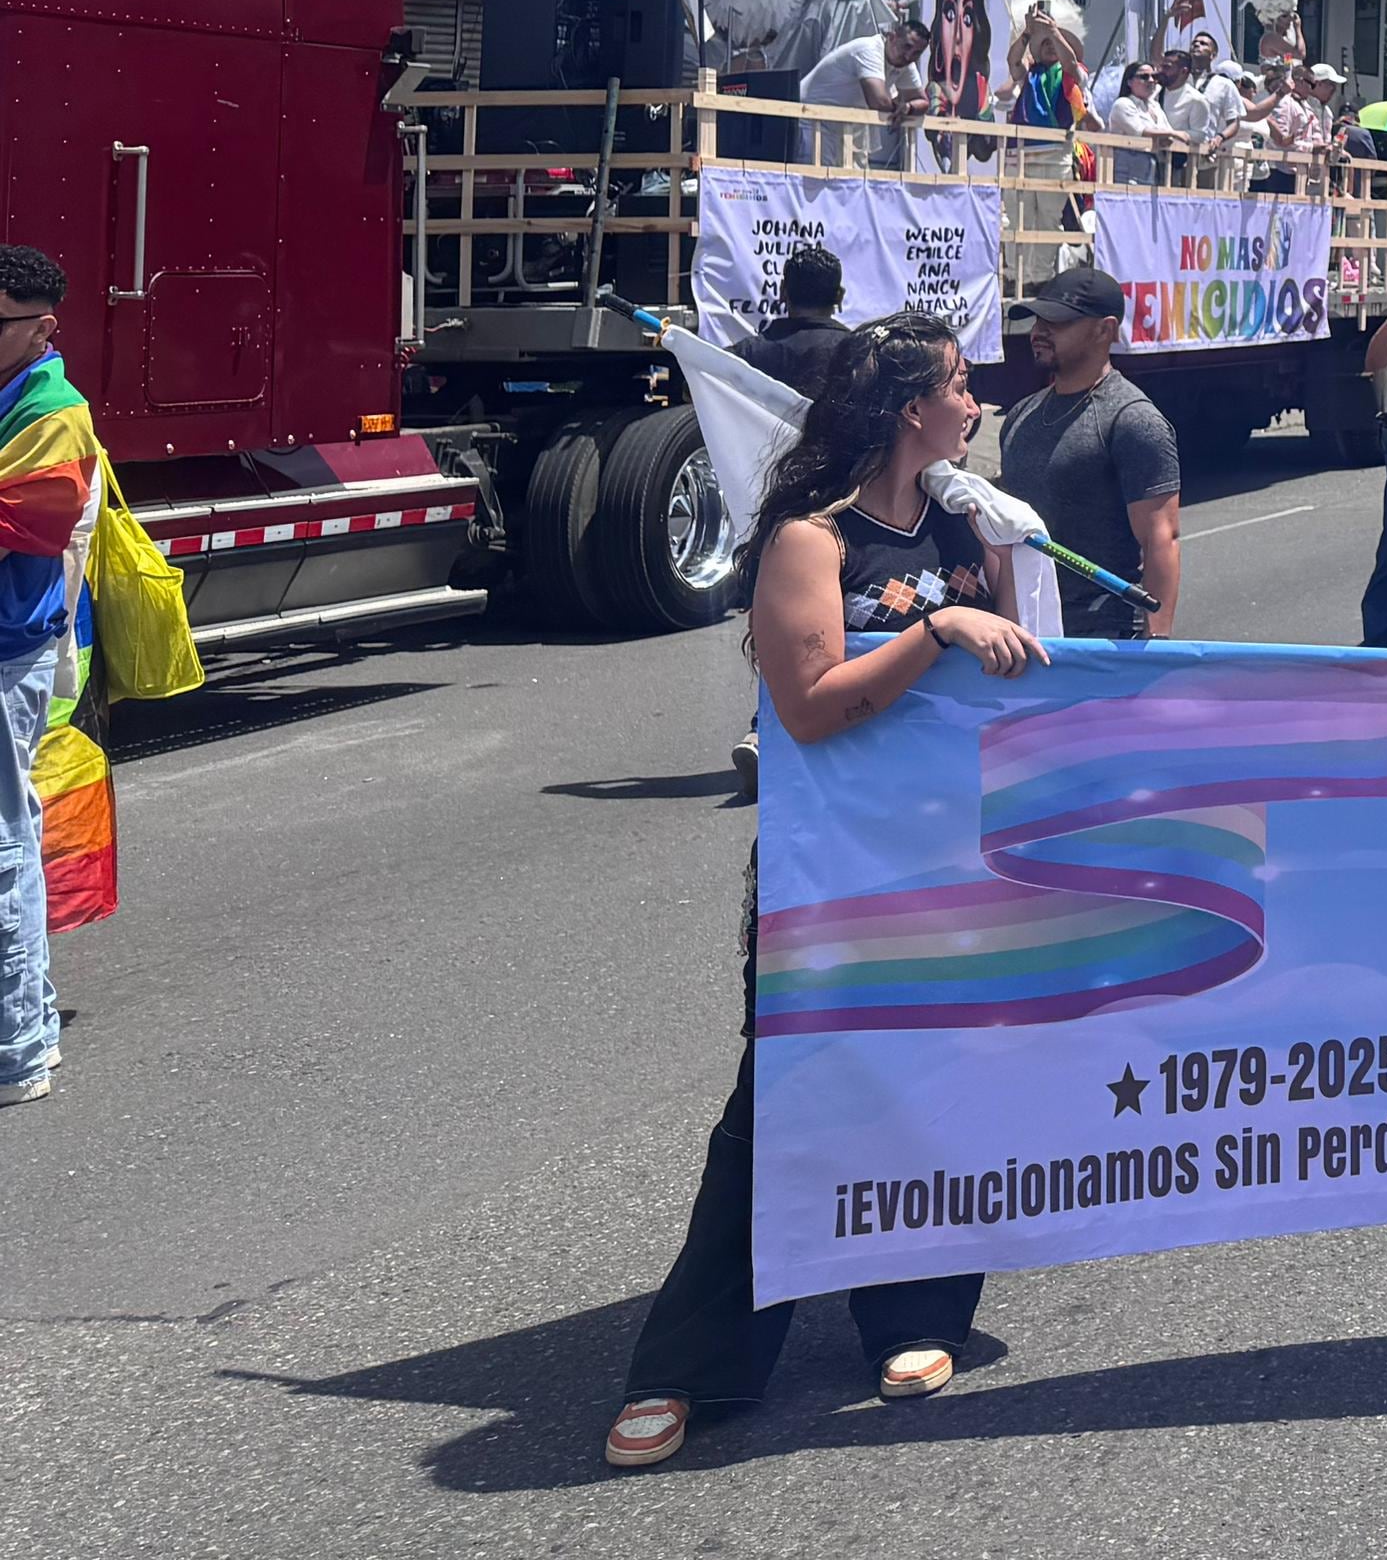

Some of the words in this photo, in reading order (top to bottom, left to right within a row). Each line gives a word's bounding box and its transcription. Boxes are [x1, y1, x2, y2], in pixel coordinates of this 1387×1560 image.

[752, 220, 825, 240] JOHANA
[905, 227, 965, 243] WENDY
[906, 244, 963, 261] EMILCE
[1179, 234, 1213, 272] NO
[1215, 235, 1265, 273] MAS
[917, 262, 951, 278] ANA
[907, 279, 960, 297] NANCY
[904, 296, 968, 314] NATALIA
[834, 1142, 1200, 1239] ¡Evolucionamos
[1214, 1126, 1281, 1191] Sin
